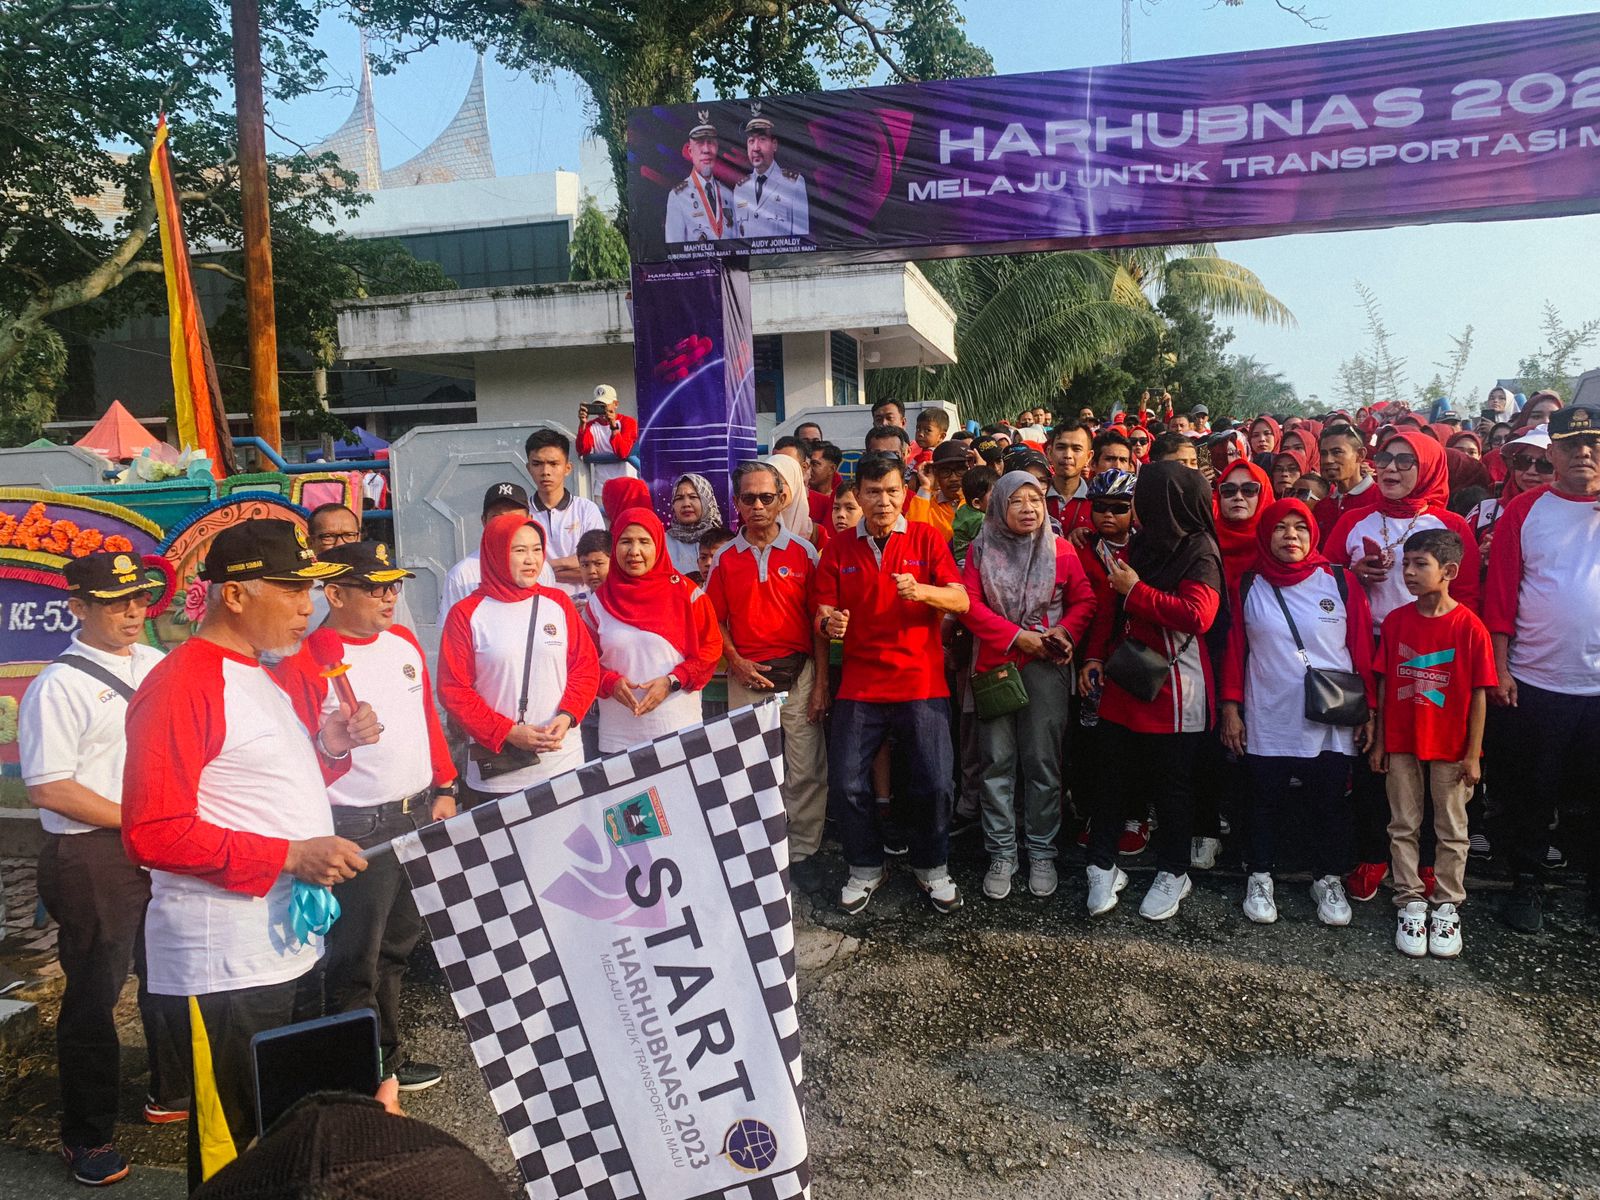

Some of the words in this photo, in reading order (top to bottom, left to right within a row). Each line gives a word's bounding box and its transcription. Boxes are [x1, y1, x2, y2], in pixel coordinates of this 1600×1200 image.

[939, 87, 1423, 165] HARHUBNAS
[908, 169, 1067, 202] MELAJU
[1078, 160, 1209, 188] UNTUK
[1223, 129, 1567, 179] TRANSPORTASI
[683, 243, 715, 252] MAHYELDI
[751, 240, 769, 248] AUDY
[770, 238, 801, 247] JOINALDY
[625, 858, 756, 1102] START
[600, 953, 624, 1001] MELAJU
[618, 1005, 641, 1046] UNTUK
[633, 1047, 673, 1136] TRANSPORTASI
[665, 1138, 685, 1168] MAJU
[612, 936, 689, 1111] HARHUBNAS
[674, 1114, 710, 1170] 2023
